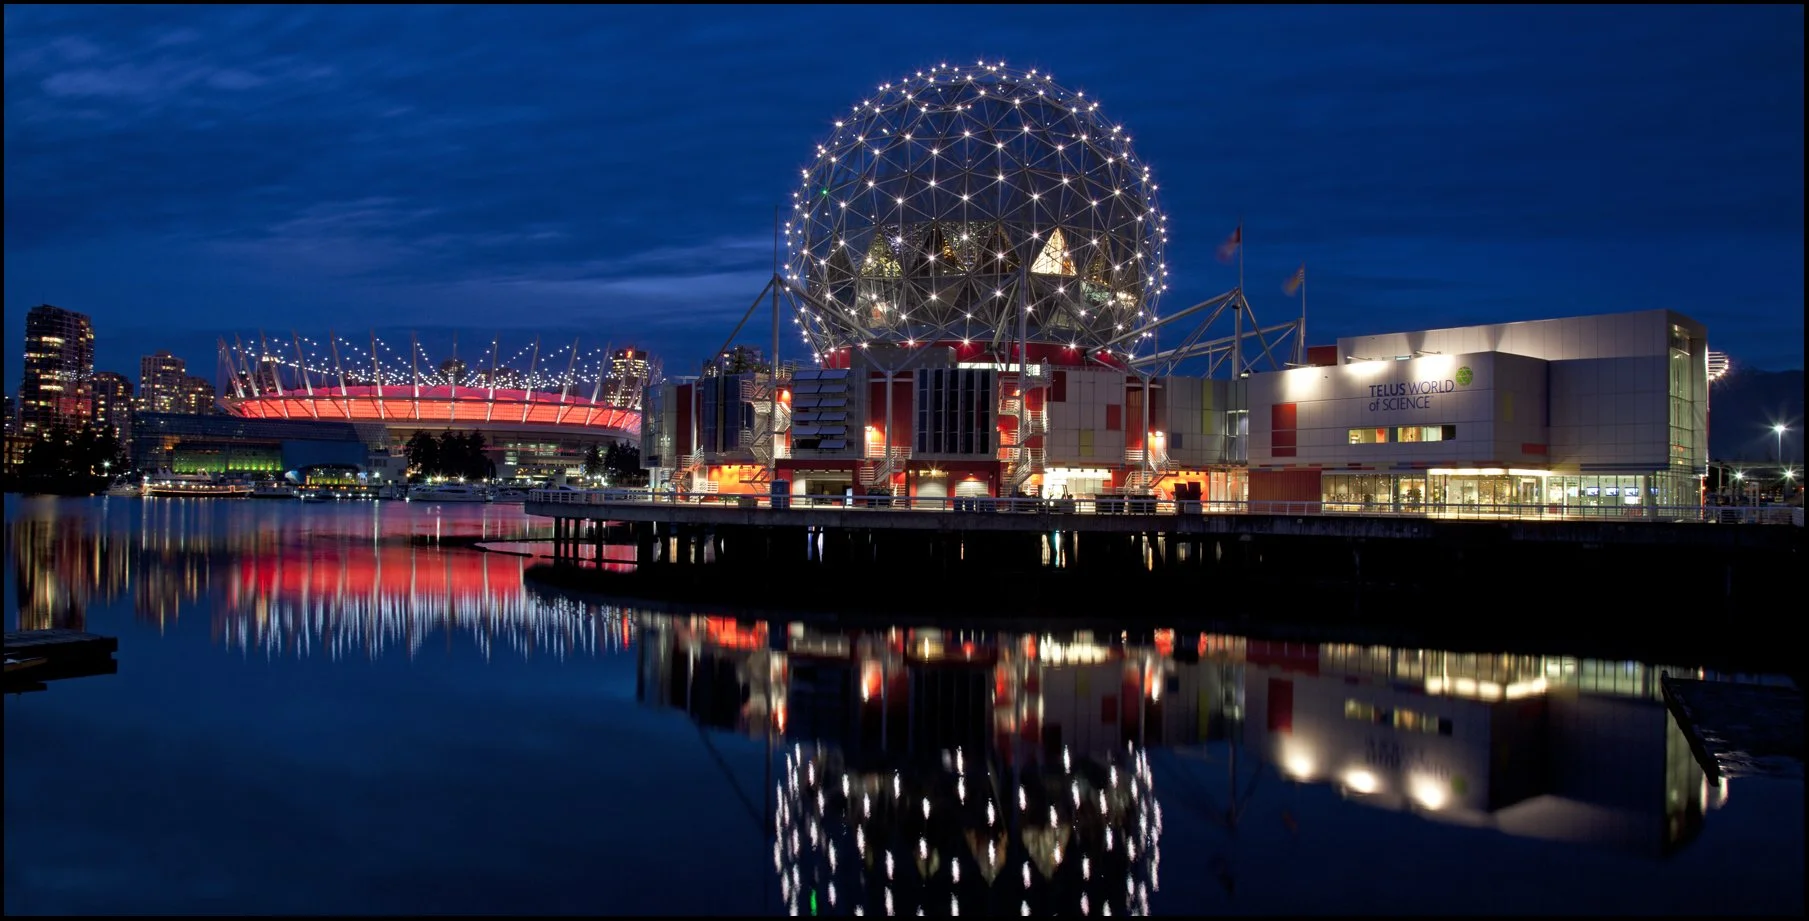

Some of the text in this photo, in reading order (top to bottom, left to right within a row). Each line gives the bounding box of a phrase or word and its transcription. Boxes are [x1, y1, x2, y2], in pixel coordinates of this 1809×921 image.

[1369, 380, 1454, 397] TELUS WORLD
[1369, 396, 1431, 411] of SCIENCE
